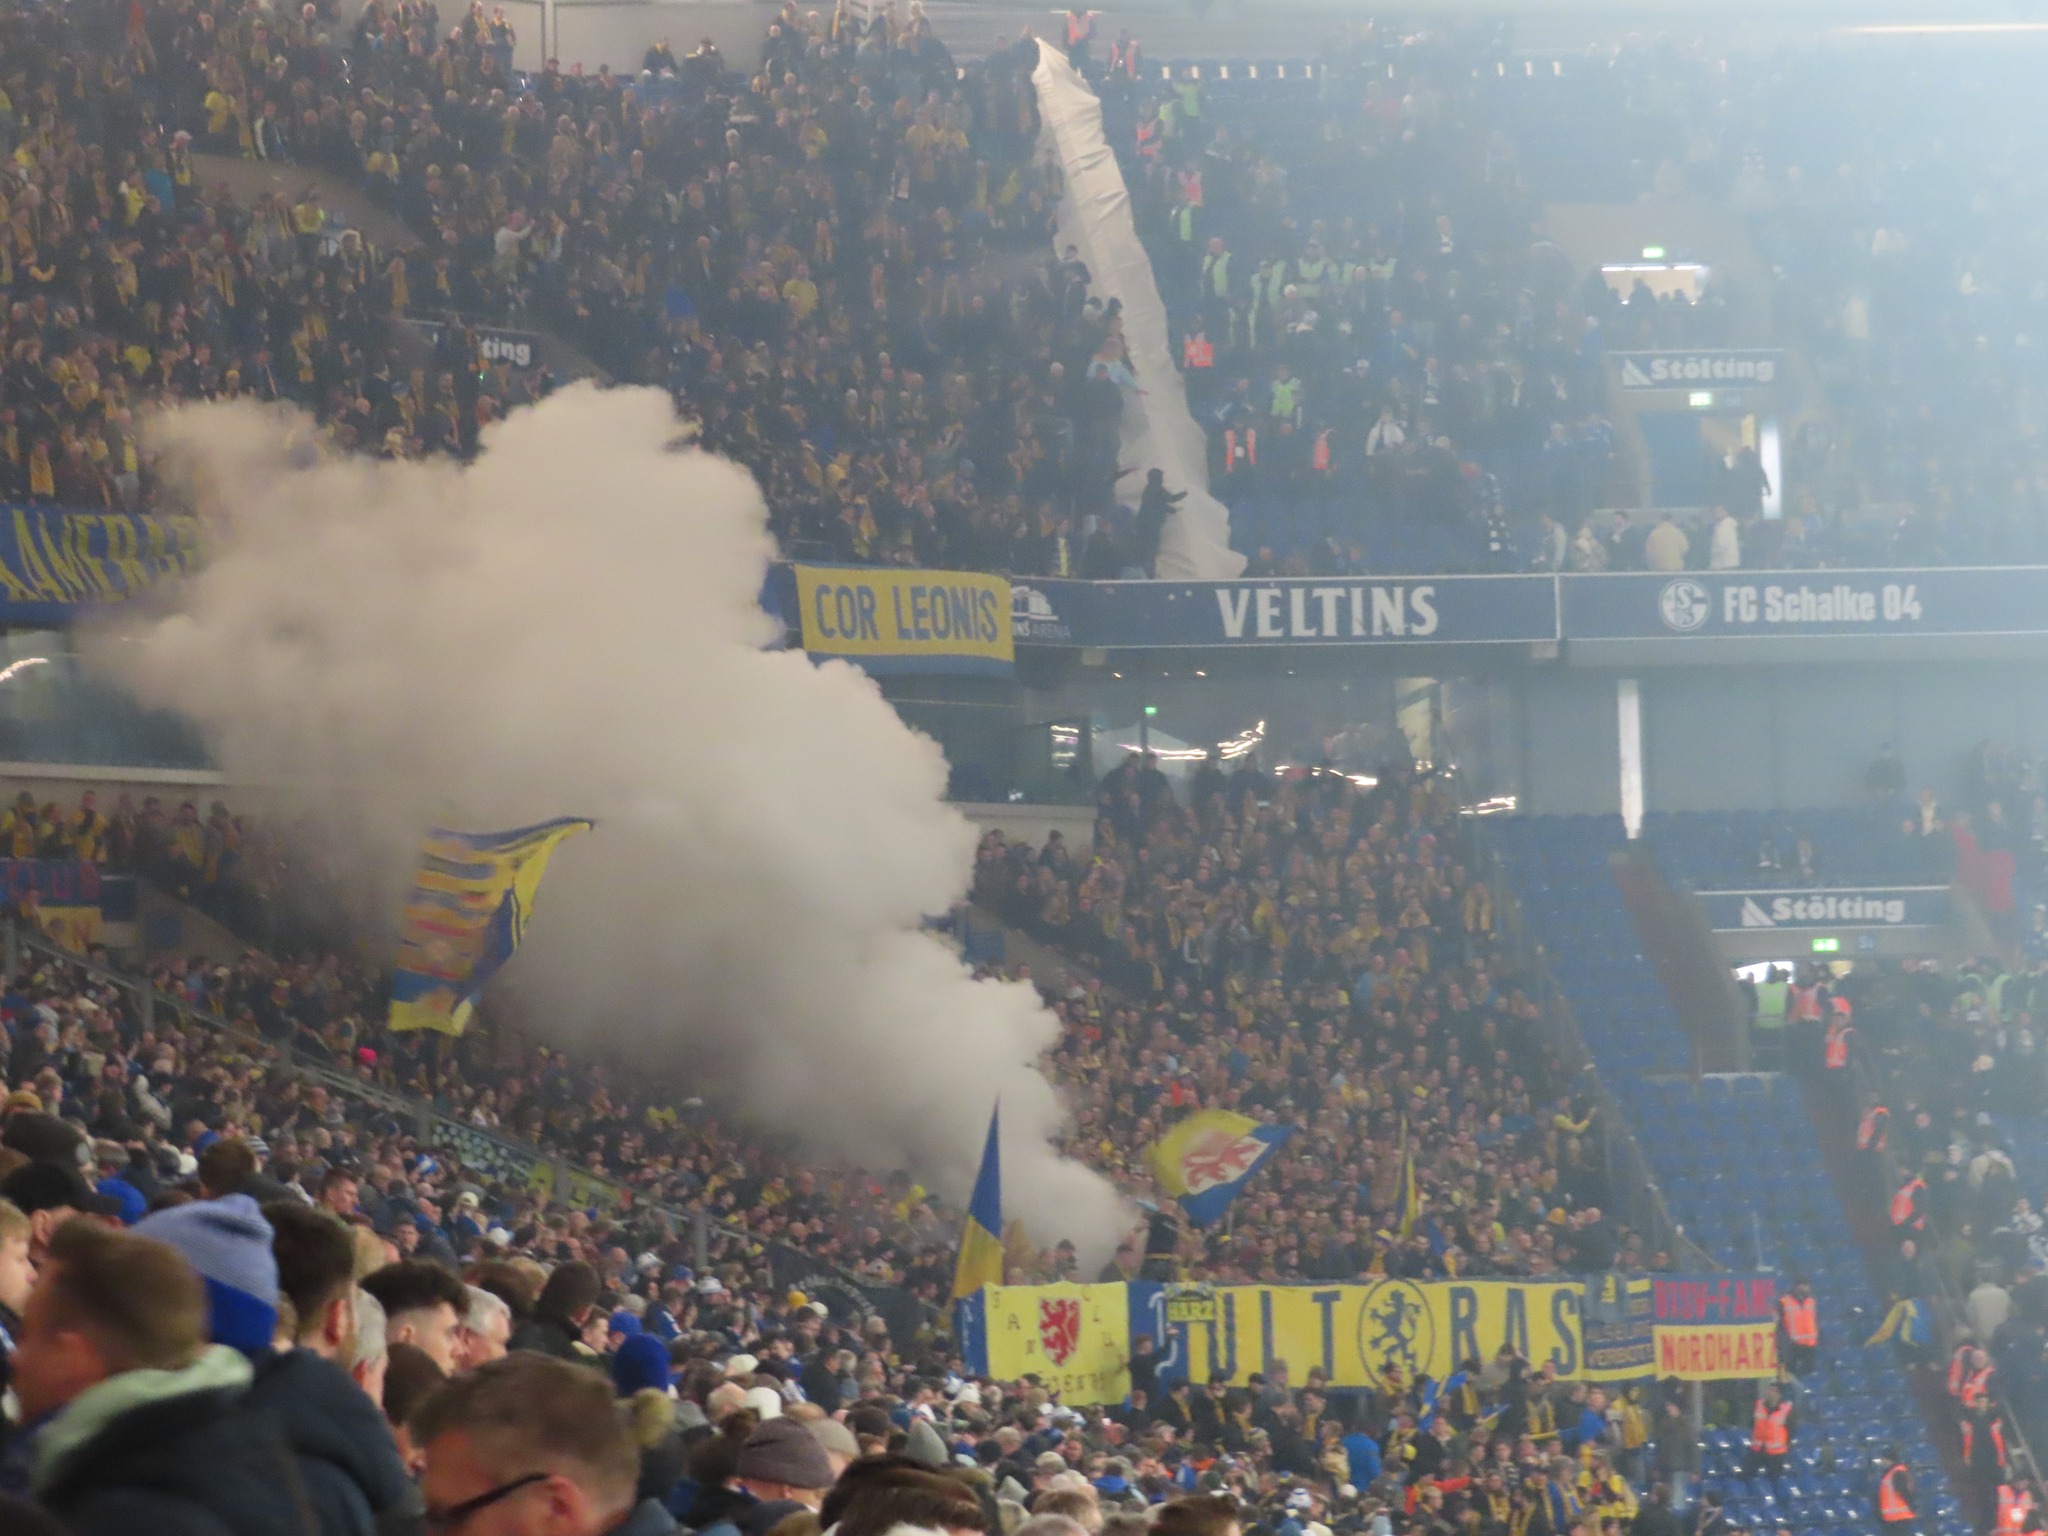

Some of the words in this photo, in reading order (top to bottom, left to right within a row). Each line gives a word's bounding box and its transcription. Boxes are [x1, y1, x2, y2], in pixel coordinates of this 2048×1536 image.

[815, 584, 879, 640] COR
[892, 586, 997, 642] LEONIS
[1216, 586, 1438, 637] VELTINS
[1723, 586, 1758, 622] FC
[1764, 585, 1876, 622] Schalke
[1882, 584, 1923, 621] 04
[1771, 895, 1905, 922] Stölting
[1661, 1332, 1776, 1372] NORDHARZ
